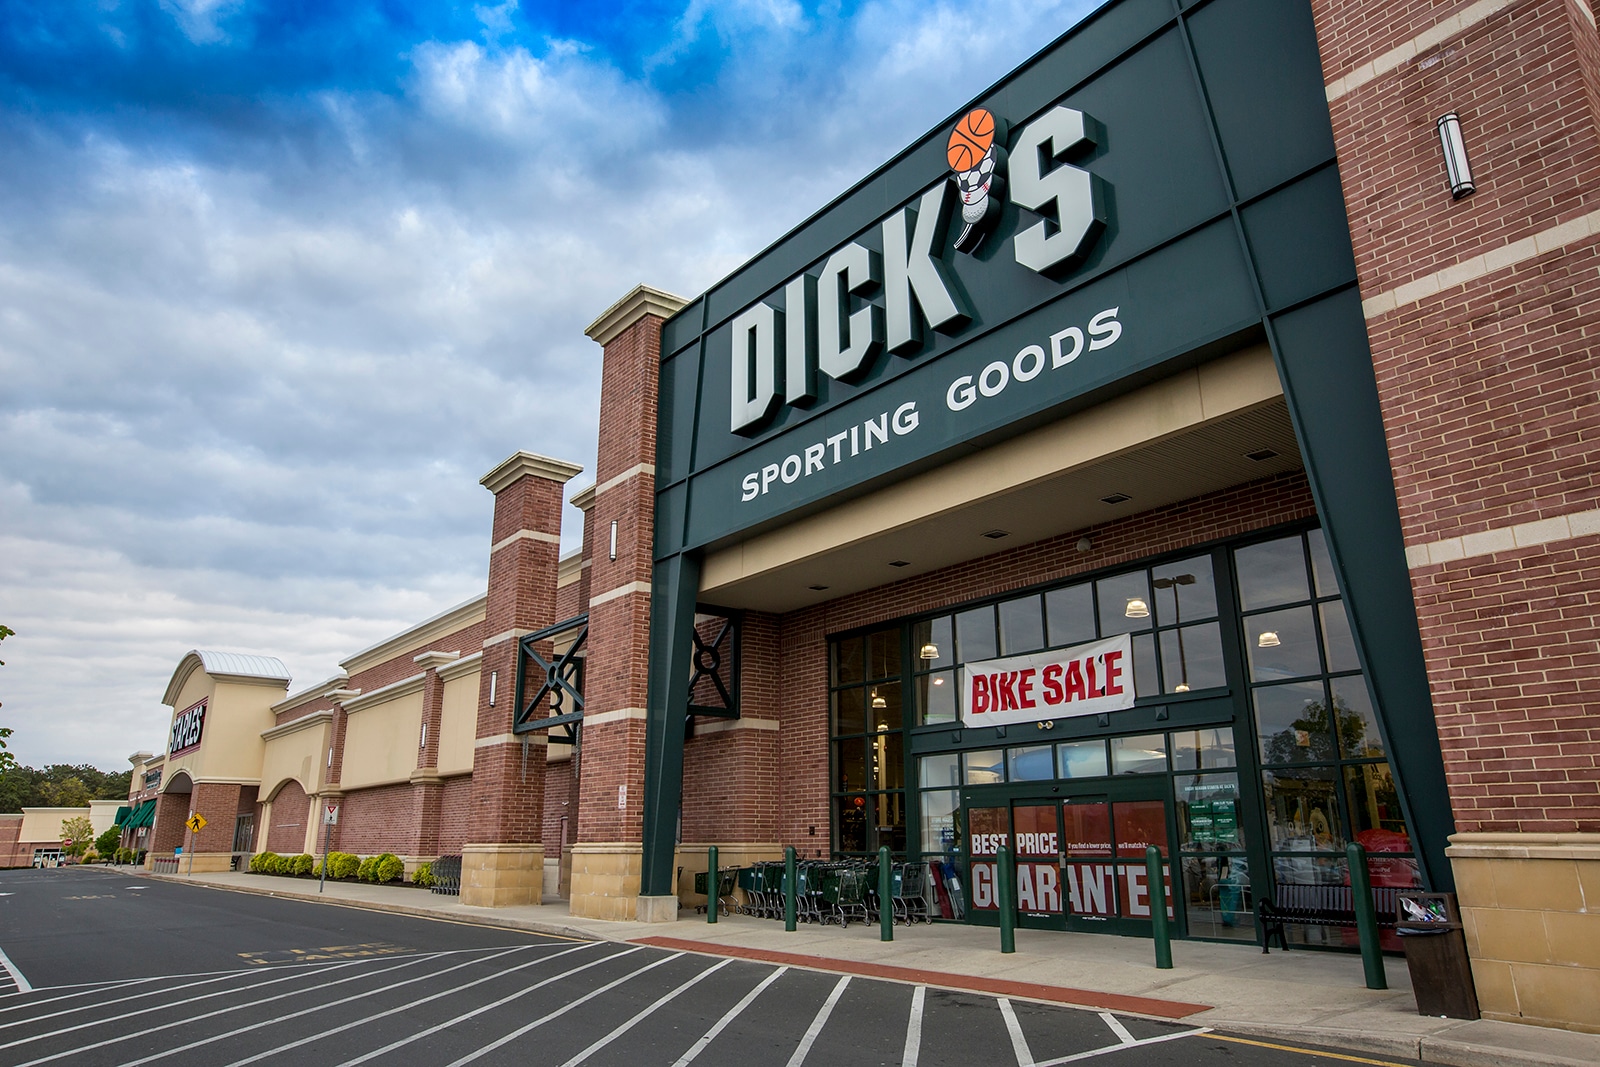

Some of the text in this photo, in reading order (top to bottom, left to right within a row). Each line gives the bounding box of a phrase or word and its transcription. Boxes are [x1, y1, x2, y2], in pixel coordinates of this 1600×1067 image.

[730, 105, 1104, 438] DICK'S
[740, 306, 1123, 503] SPORTING GOODS
[971, 650, 1124, 714] BIKE SALE
[169, 705, 203, 754] STAPLES
[971, 832, 1058, 855] BEST PRICE
